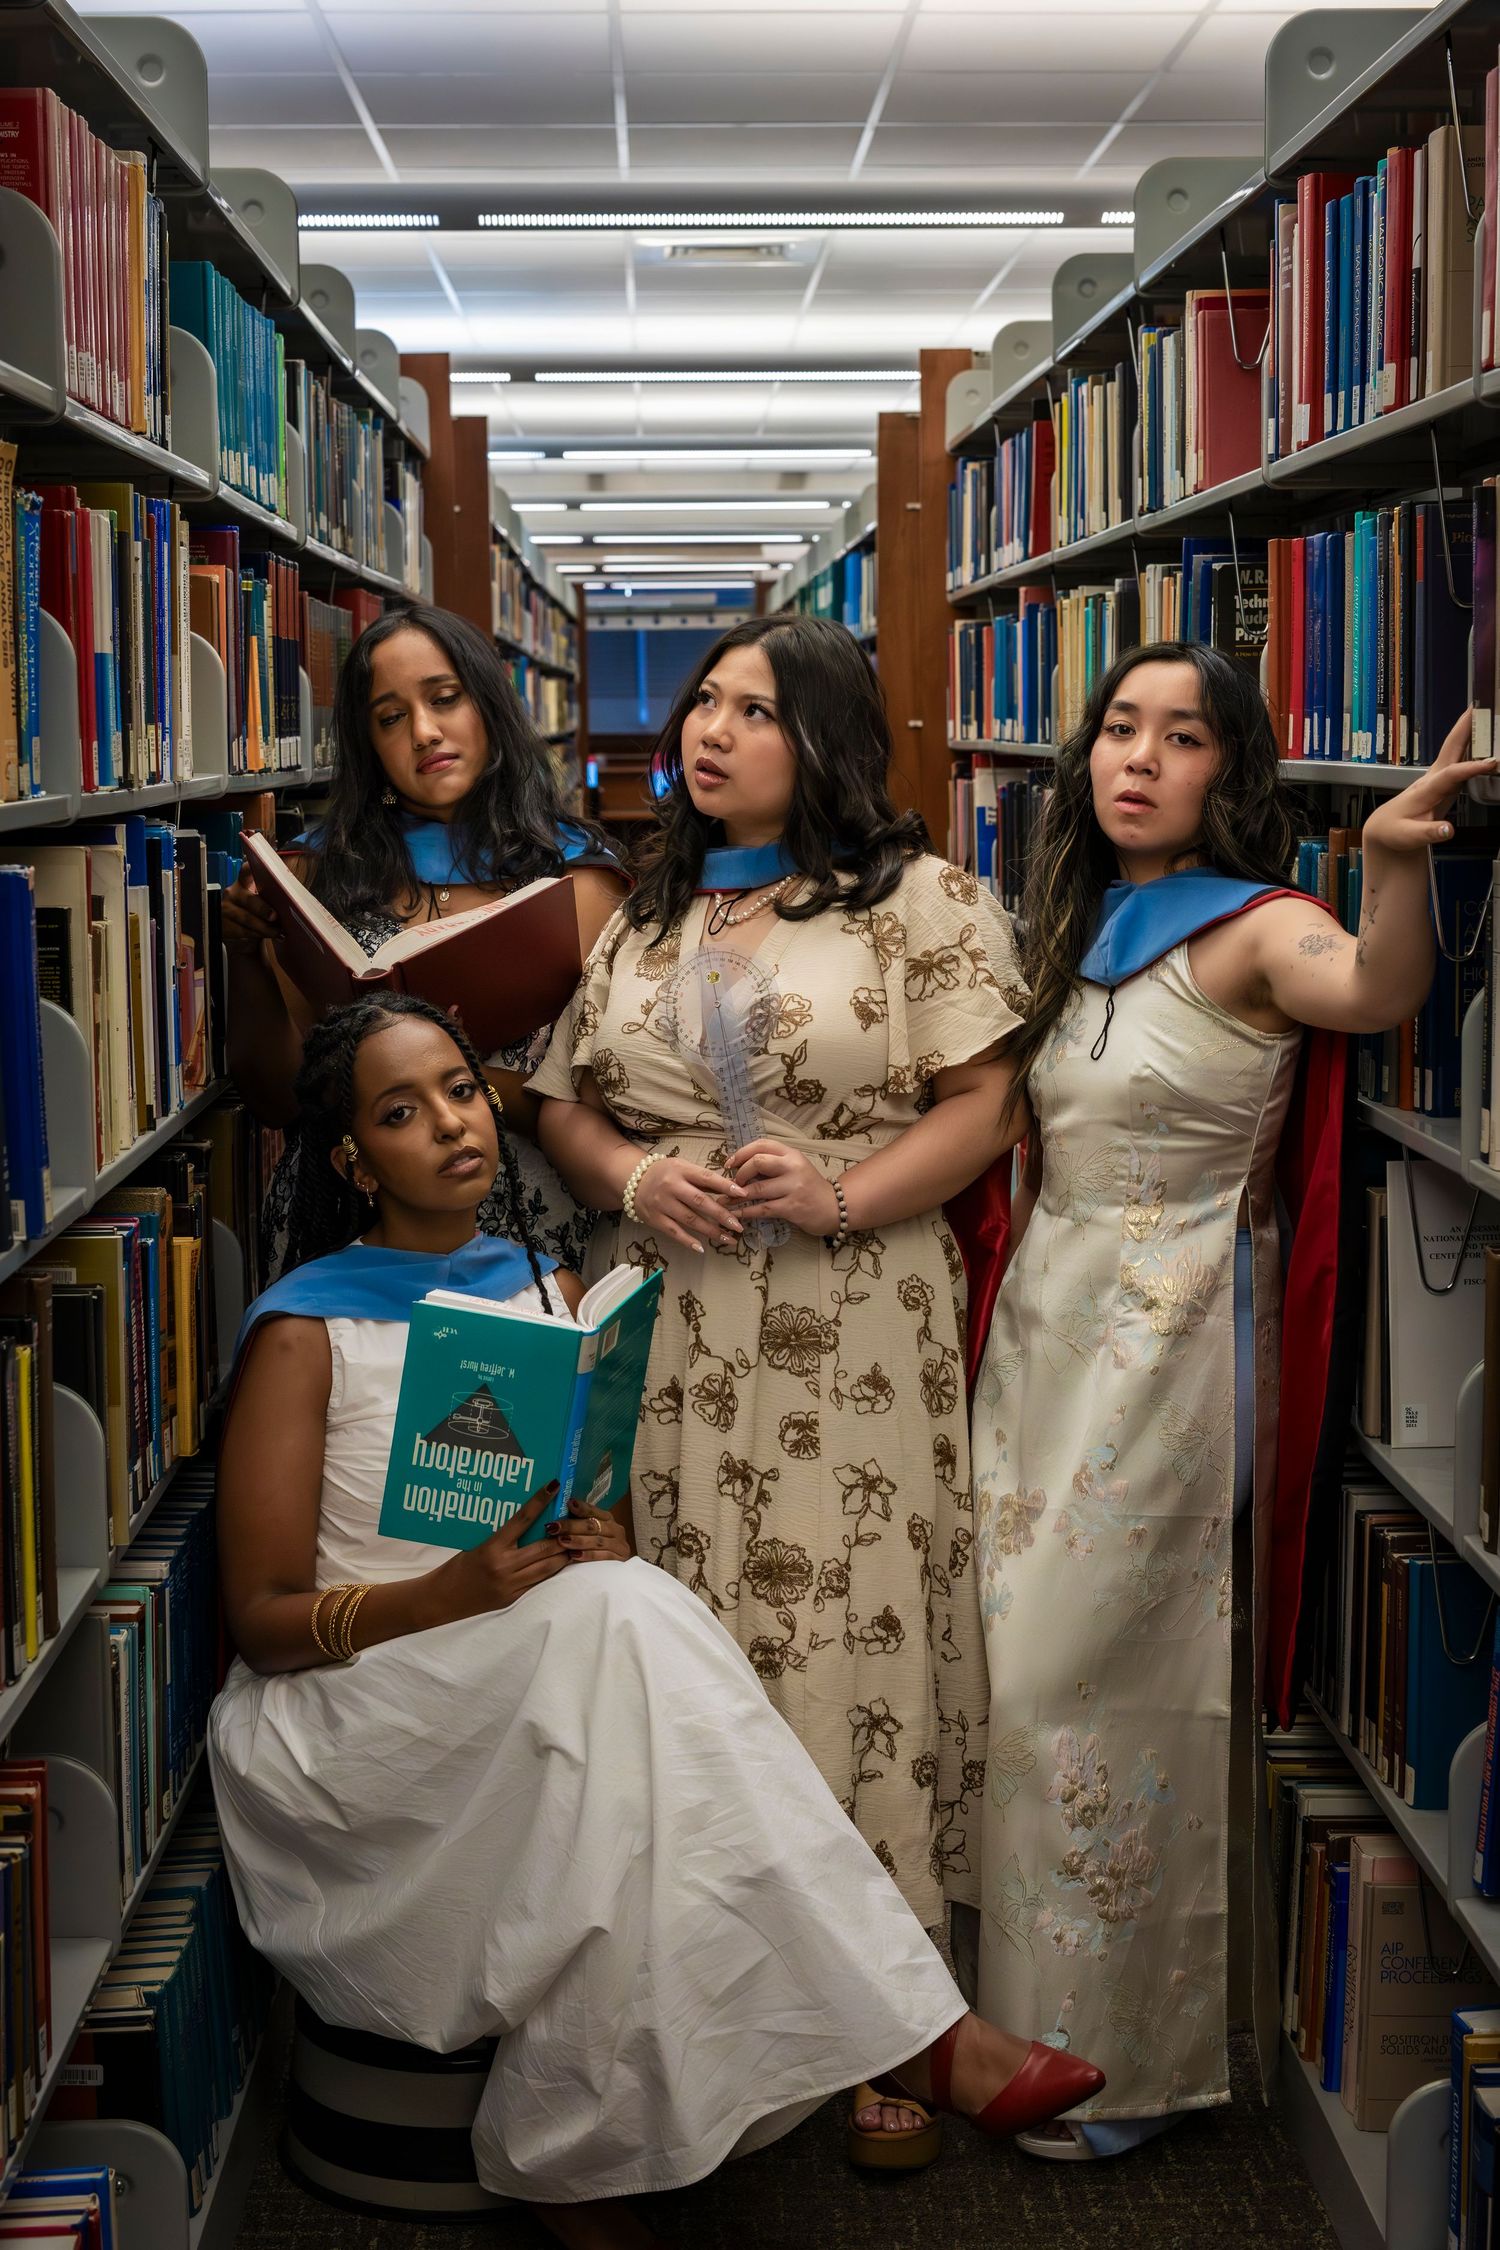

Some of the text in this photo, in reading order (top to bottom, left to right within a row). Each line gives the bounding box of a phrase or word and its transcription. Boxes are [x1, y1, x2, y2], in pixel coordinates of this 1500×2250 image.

[1378, 215, 1386, 292] HADRONIC
[1354, 289, 1361, 305] OF
[4, 459, 13, 552] CHEMICAL
[1, 580, 9, 669] ANALYSIS
[7, 559, 15, 665] PRINCIPLES
[27, 522, 37, 714] A Conceptual Approach
[130, 1298, 138, 1381] LABORATORY
[459, 1359, 479, 1373] Hurst
[480, 1361, 506, 1378] Jeffrey
[411, 1432, 535, 1492] Laboratory
[456, 1477, 483, 1495] in the
[1487, 1693, 1498, 1761] FORMATION
[1482, 1761, 1493, 1787] AND
[1476, 1787, 1489, 1853] EVOLUTION
[1380, 1942, 1404, 1955] AIP
[1380, 1970, 1483, 1985] PROCEEDINGS
[1380, 2044, 1448, 2056] SOLIDS AND
[1381, 2034, 1439, 2046] POSITRON
[1450, 2091, 1460, 2221] COLD MOLECULES
